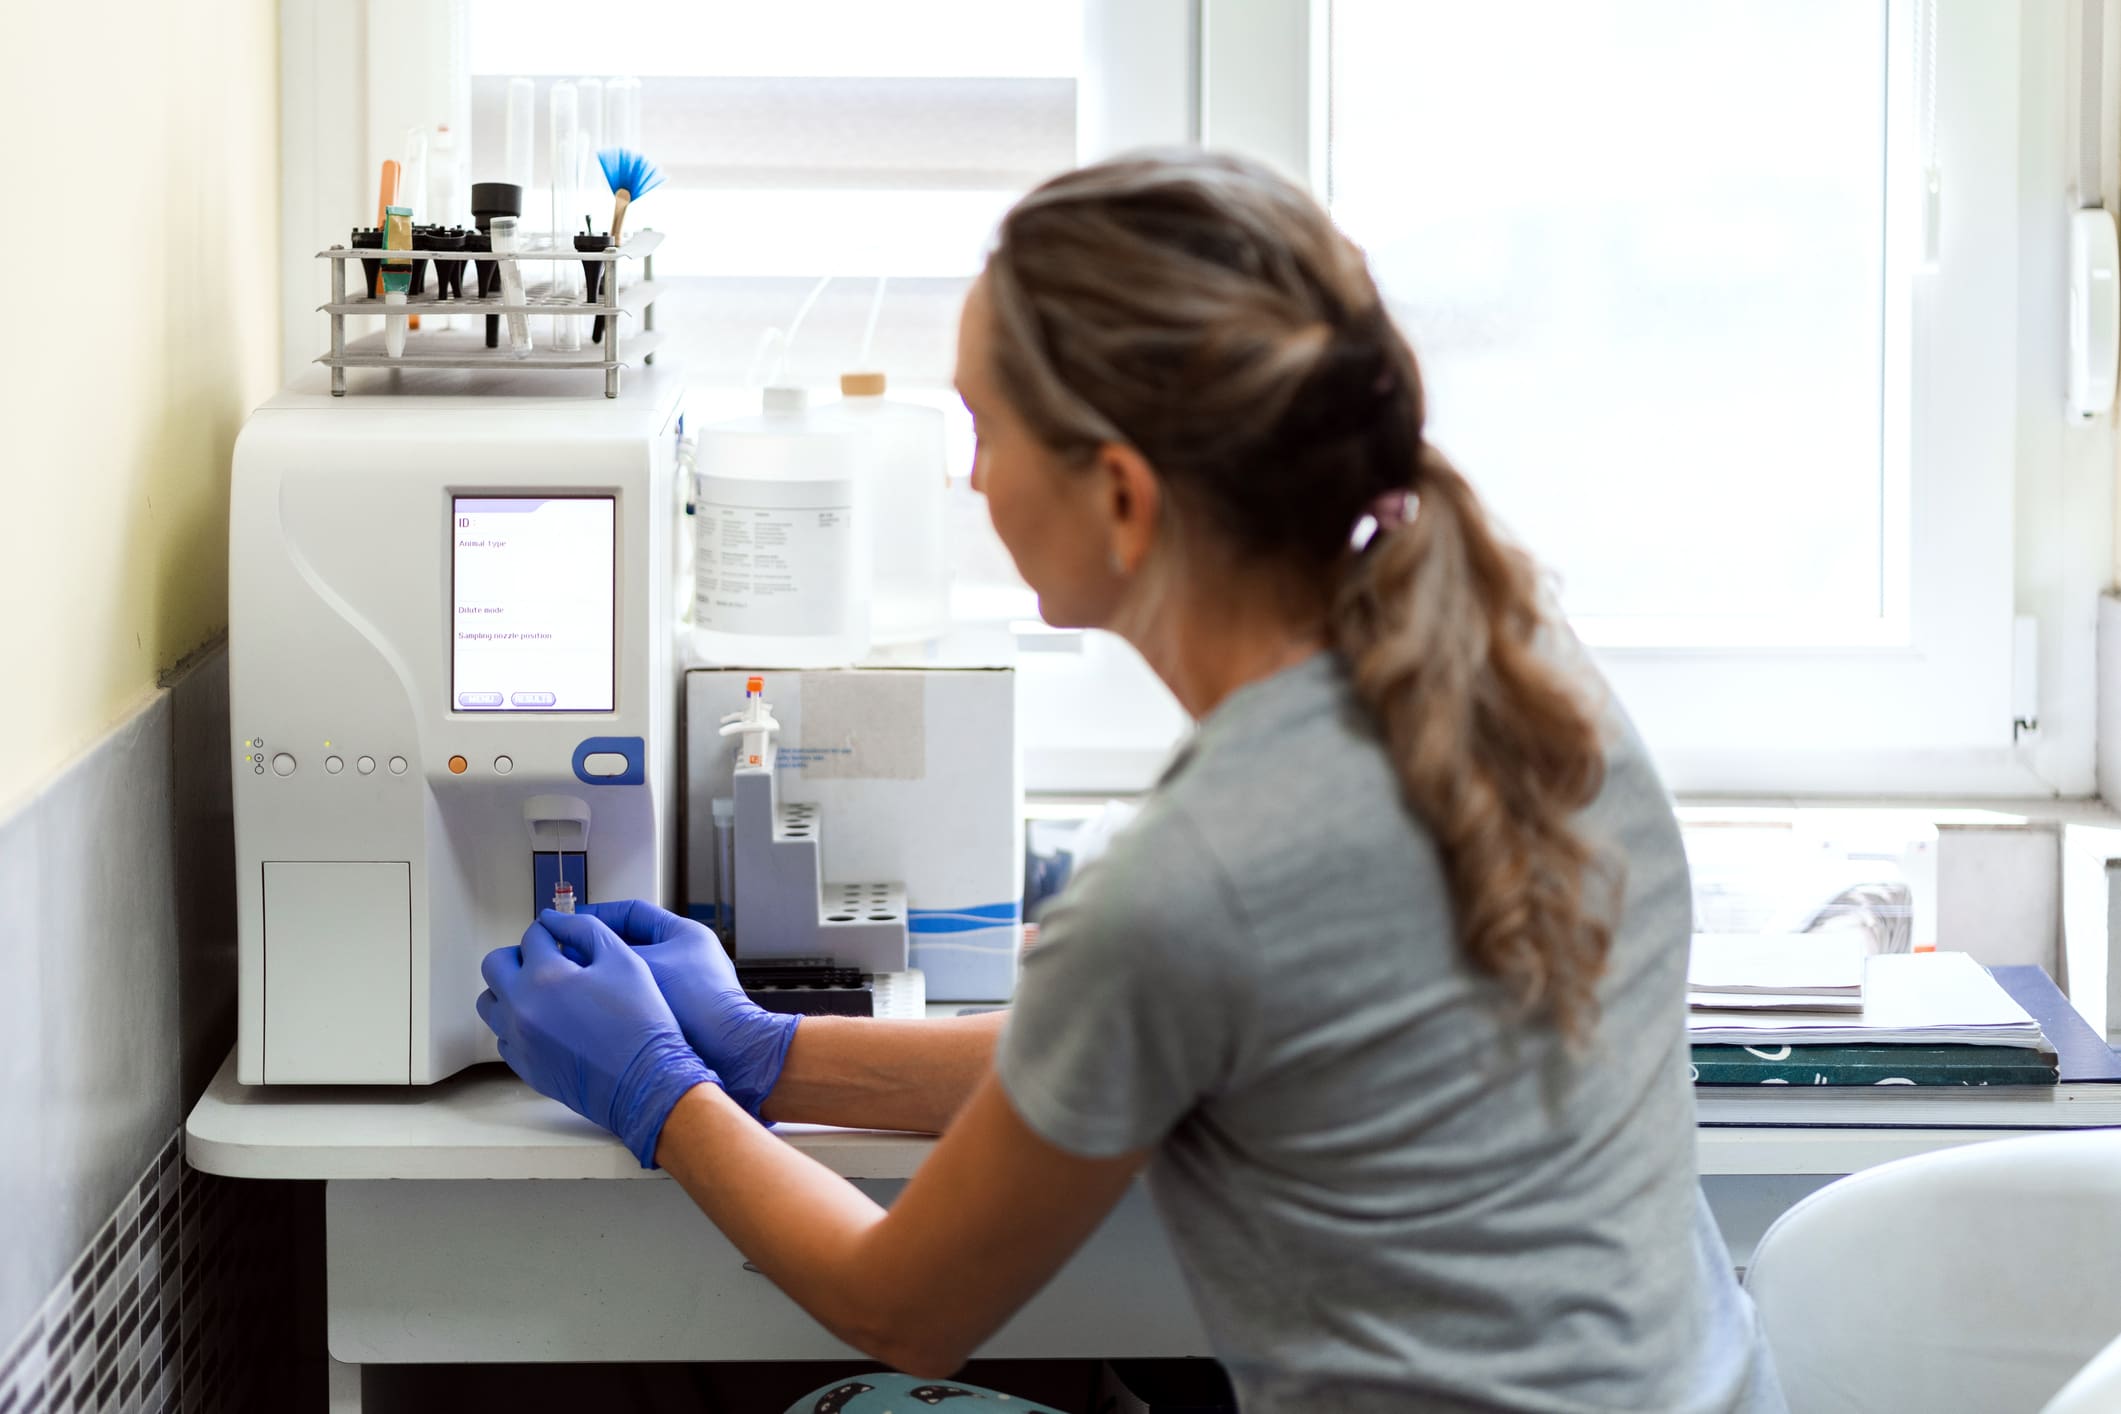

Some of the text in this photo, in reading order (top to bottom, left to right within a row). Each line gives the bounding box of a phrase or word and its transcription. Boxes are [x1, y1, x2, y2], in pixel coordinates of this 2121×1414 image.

[458, 517, 470, 528] ID
[458, 632, 492, 641] Sampling
[520, 633, 552, 641] position
